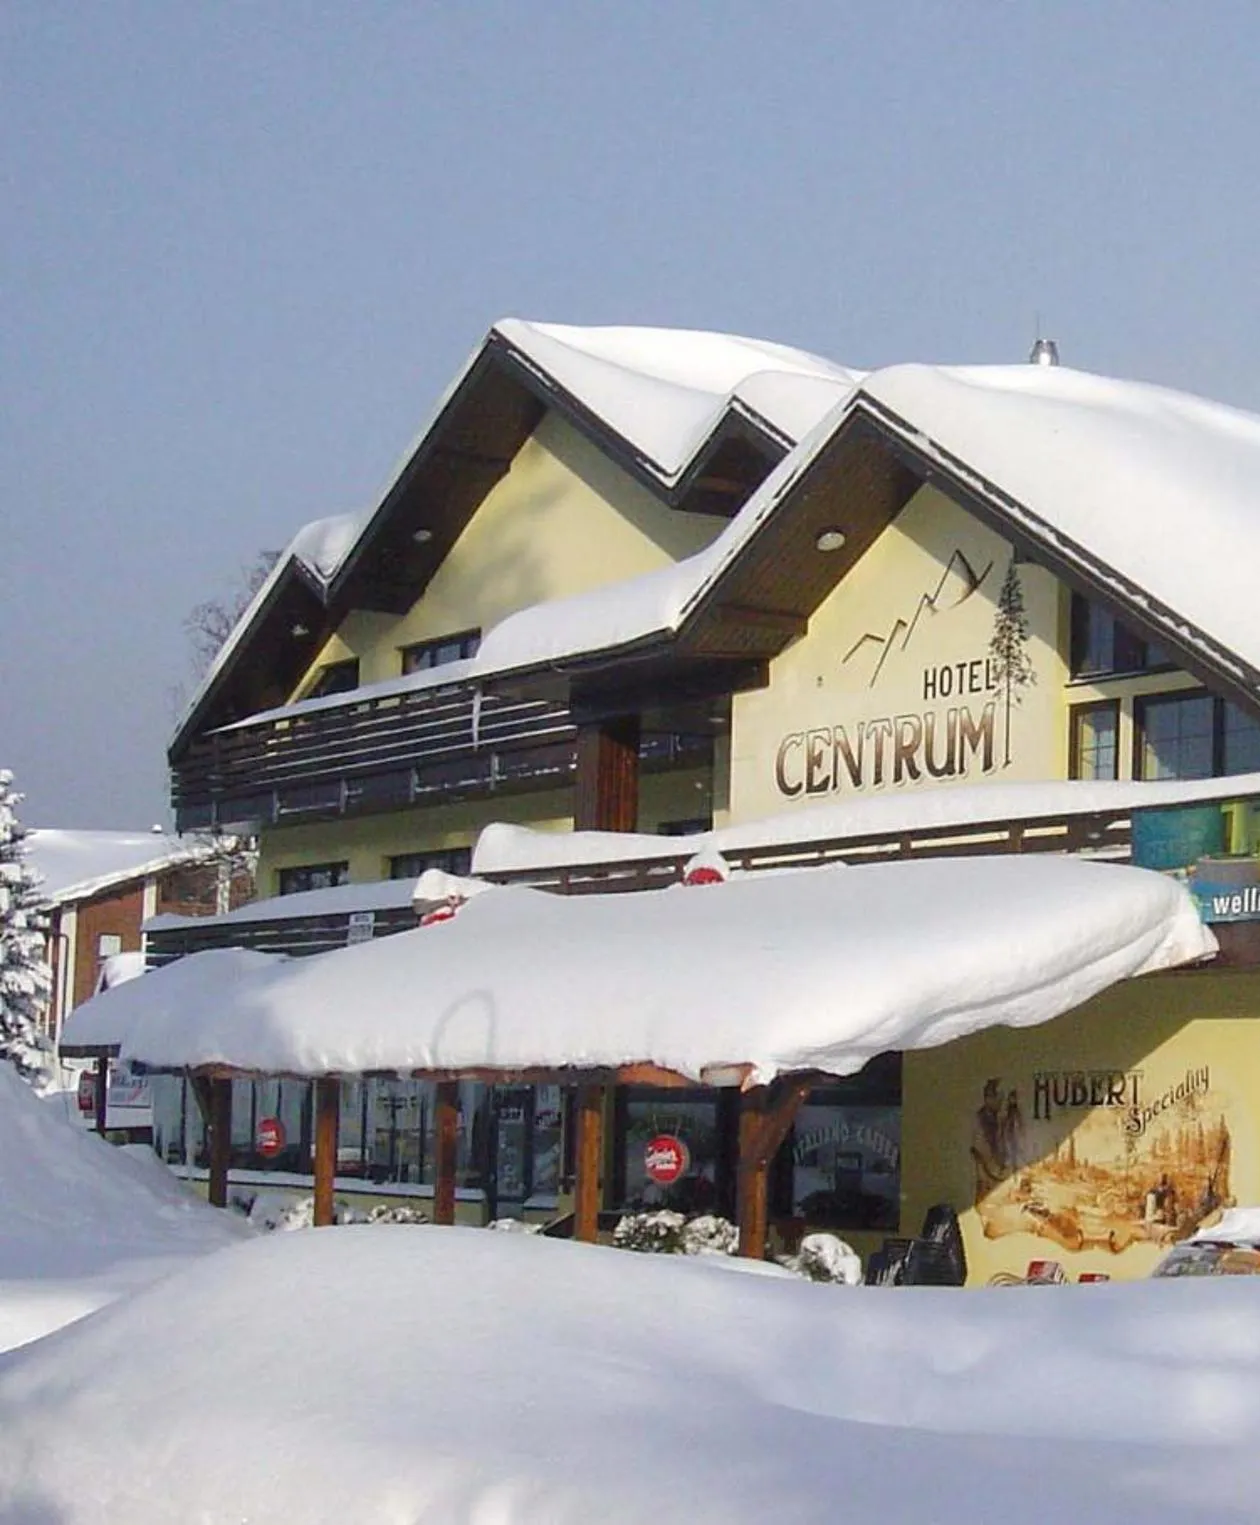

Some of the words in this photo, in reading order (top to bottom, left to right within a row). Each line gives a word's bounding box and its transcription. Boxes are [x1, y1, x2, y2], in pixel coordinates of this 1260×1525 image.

[923, 658, 997, 700] HOTEL
[775, 701, 997, 797] CENTRUM
[1032, 1069, 1145, 1120] HUBERT
